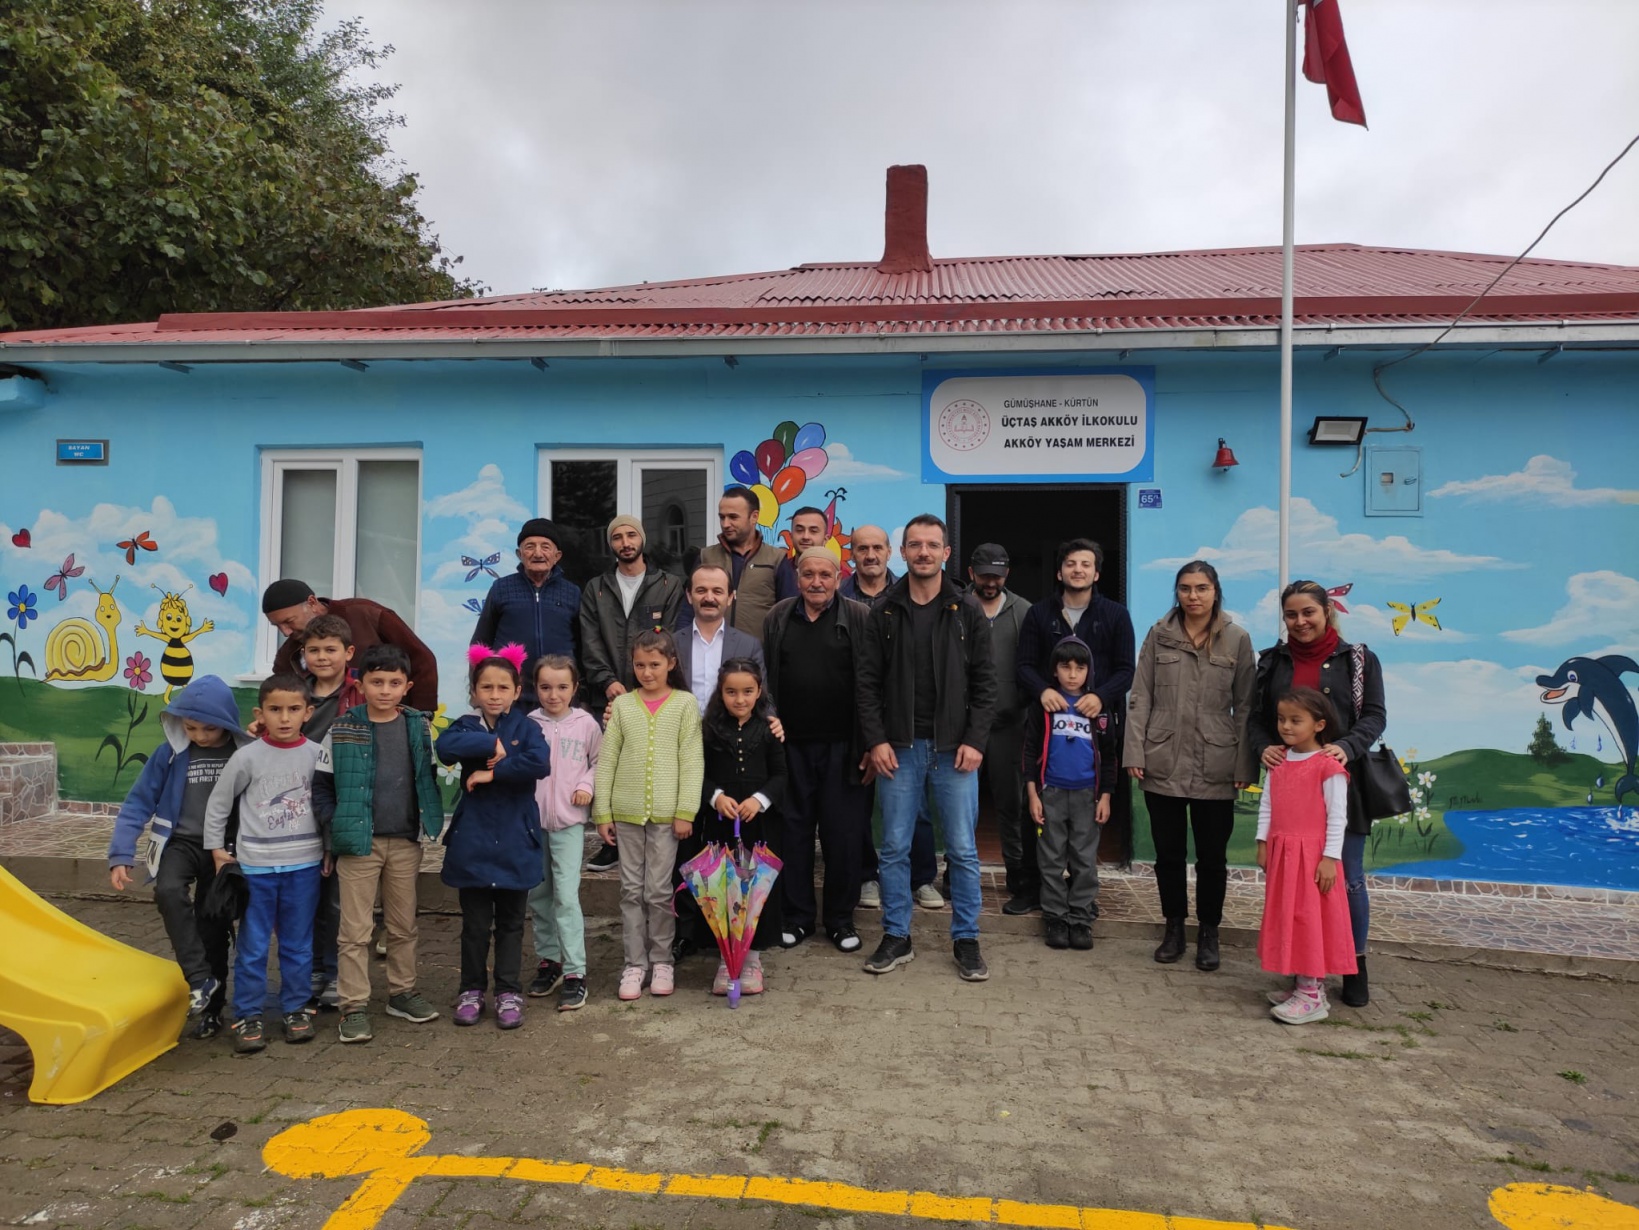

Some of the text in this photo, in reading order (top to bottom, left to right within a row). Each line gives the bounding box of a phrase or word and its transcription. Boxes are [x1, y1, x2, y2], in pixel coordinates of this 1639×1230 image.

[1003, 398, 1057, 408] GÜMÜŞHANE
[1064, 397, 1099, 407] KÜRTÜN
[1001, 414, 1138, 428] ÜÇTAŞ AKKÖY İLKOKULU
[1004, 435, 1135, 449] AKKÖY YAŞAM MERKEZİ
